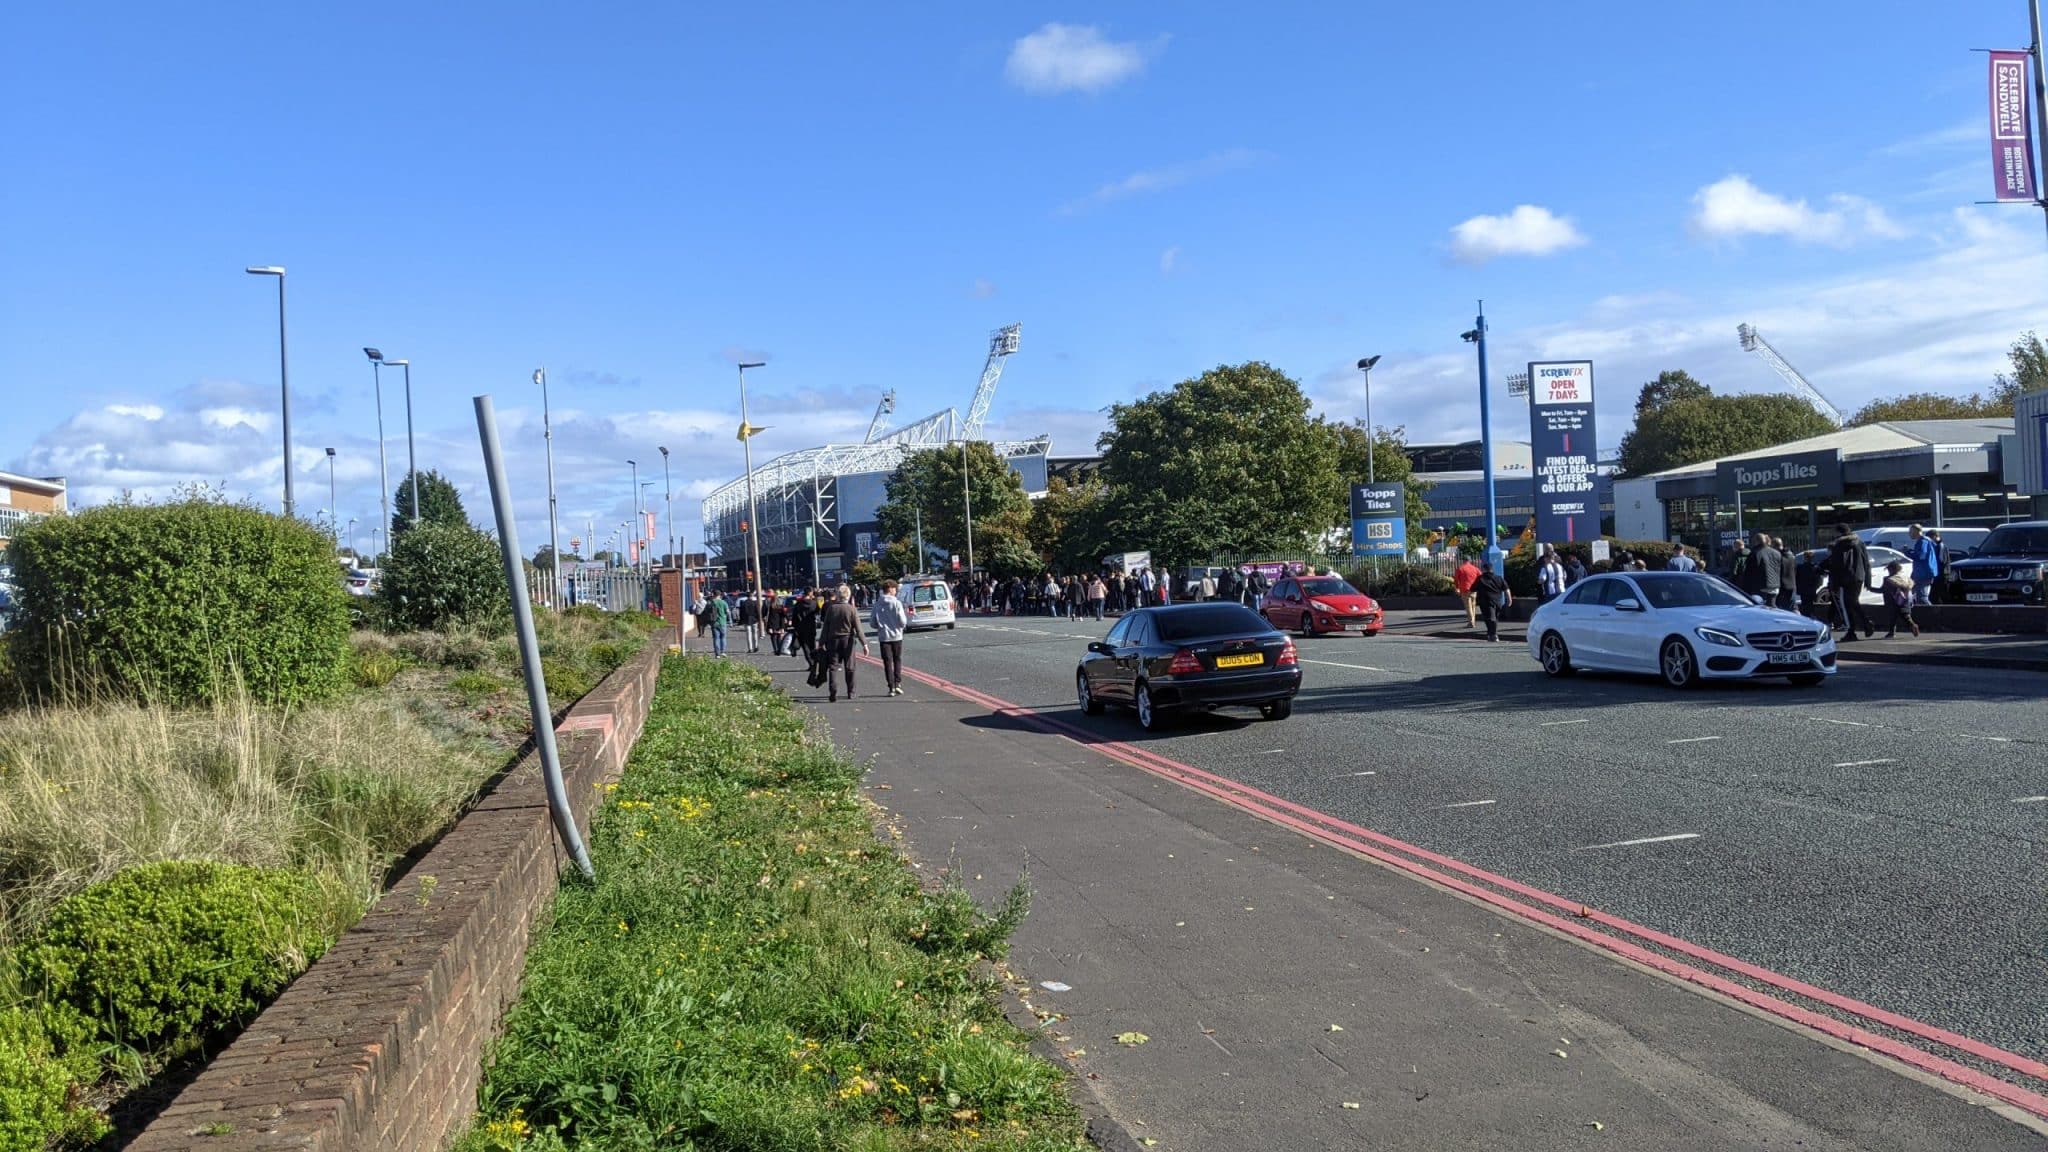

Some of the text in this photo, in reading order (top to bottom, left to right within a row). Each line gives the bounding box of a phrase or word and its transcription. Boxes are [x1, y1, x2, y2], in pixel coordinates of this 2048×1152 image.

[1999, 66, 2010, 133] SANDWELL
[2009, 66, 2021, 133] CELEBRATE
[1540, 367, 1584, 378] SCREWFIX
[1551, 380, 1575, 390] OPEN
[1549, 390, 1579, 400] 7 DAYS
[1546, 456, 1587, 466] FIND OUR
[1537, 464, 1596, 475] LATEST DEALS
[1734, 462, 1818, 486] Topps Tiles
[1548, 474, 1587, 484] & OFFERS
[1541, 482, 1594, 493] ON OUR APP
[1360, 488, 1396, 499] Topps
[1365, 500, 1391, 509] Tiles
[1369, 524, 1391, 537] HSS
[1376, 542, 1404, 550] Shops
